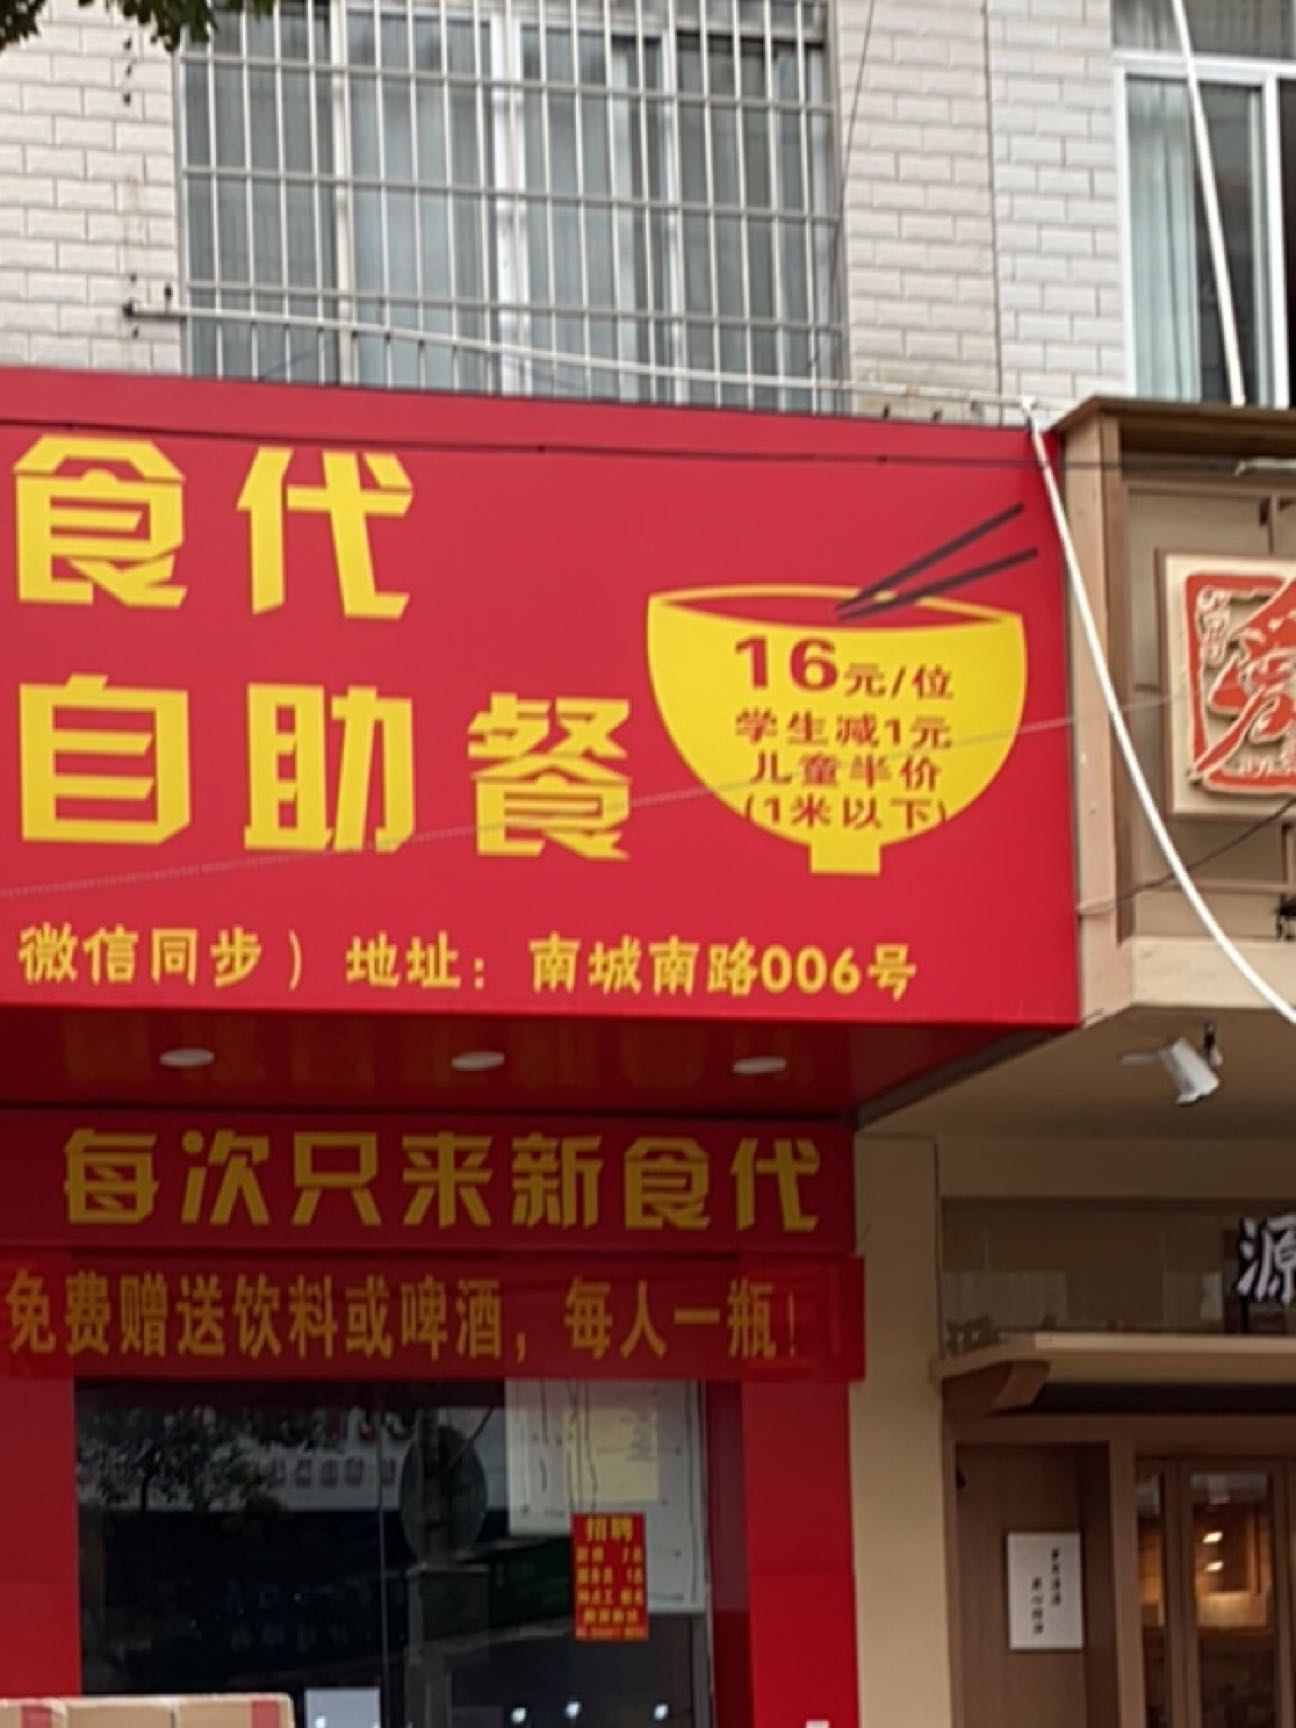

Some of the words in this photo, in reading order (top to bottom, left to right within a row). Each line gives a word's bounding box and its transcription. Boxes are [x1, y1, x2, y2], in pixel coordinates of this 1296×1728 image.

[735, 635, 954, 700] 16元/位
[735, 708, 953, 750] 学生减1元
[750, 750, 941, 792] 儿童半价
[64, 1127, 821, 1232] 每次只来新食代
